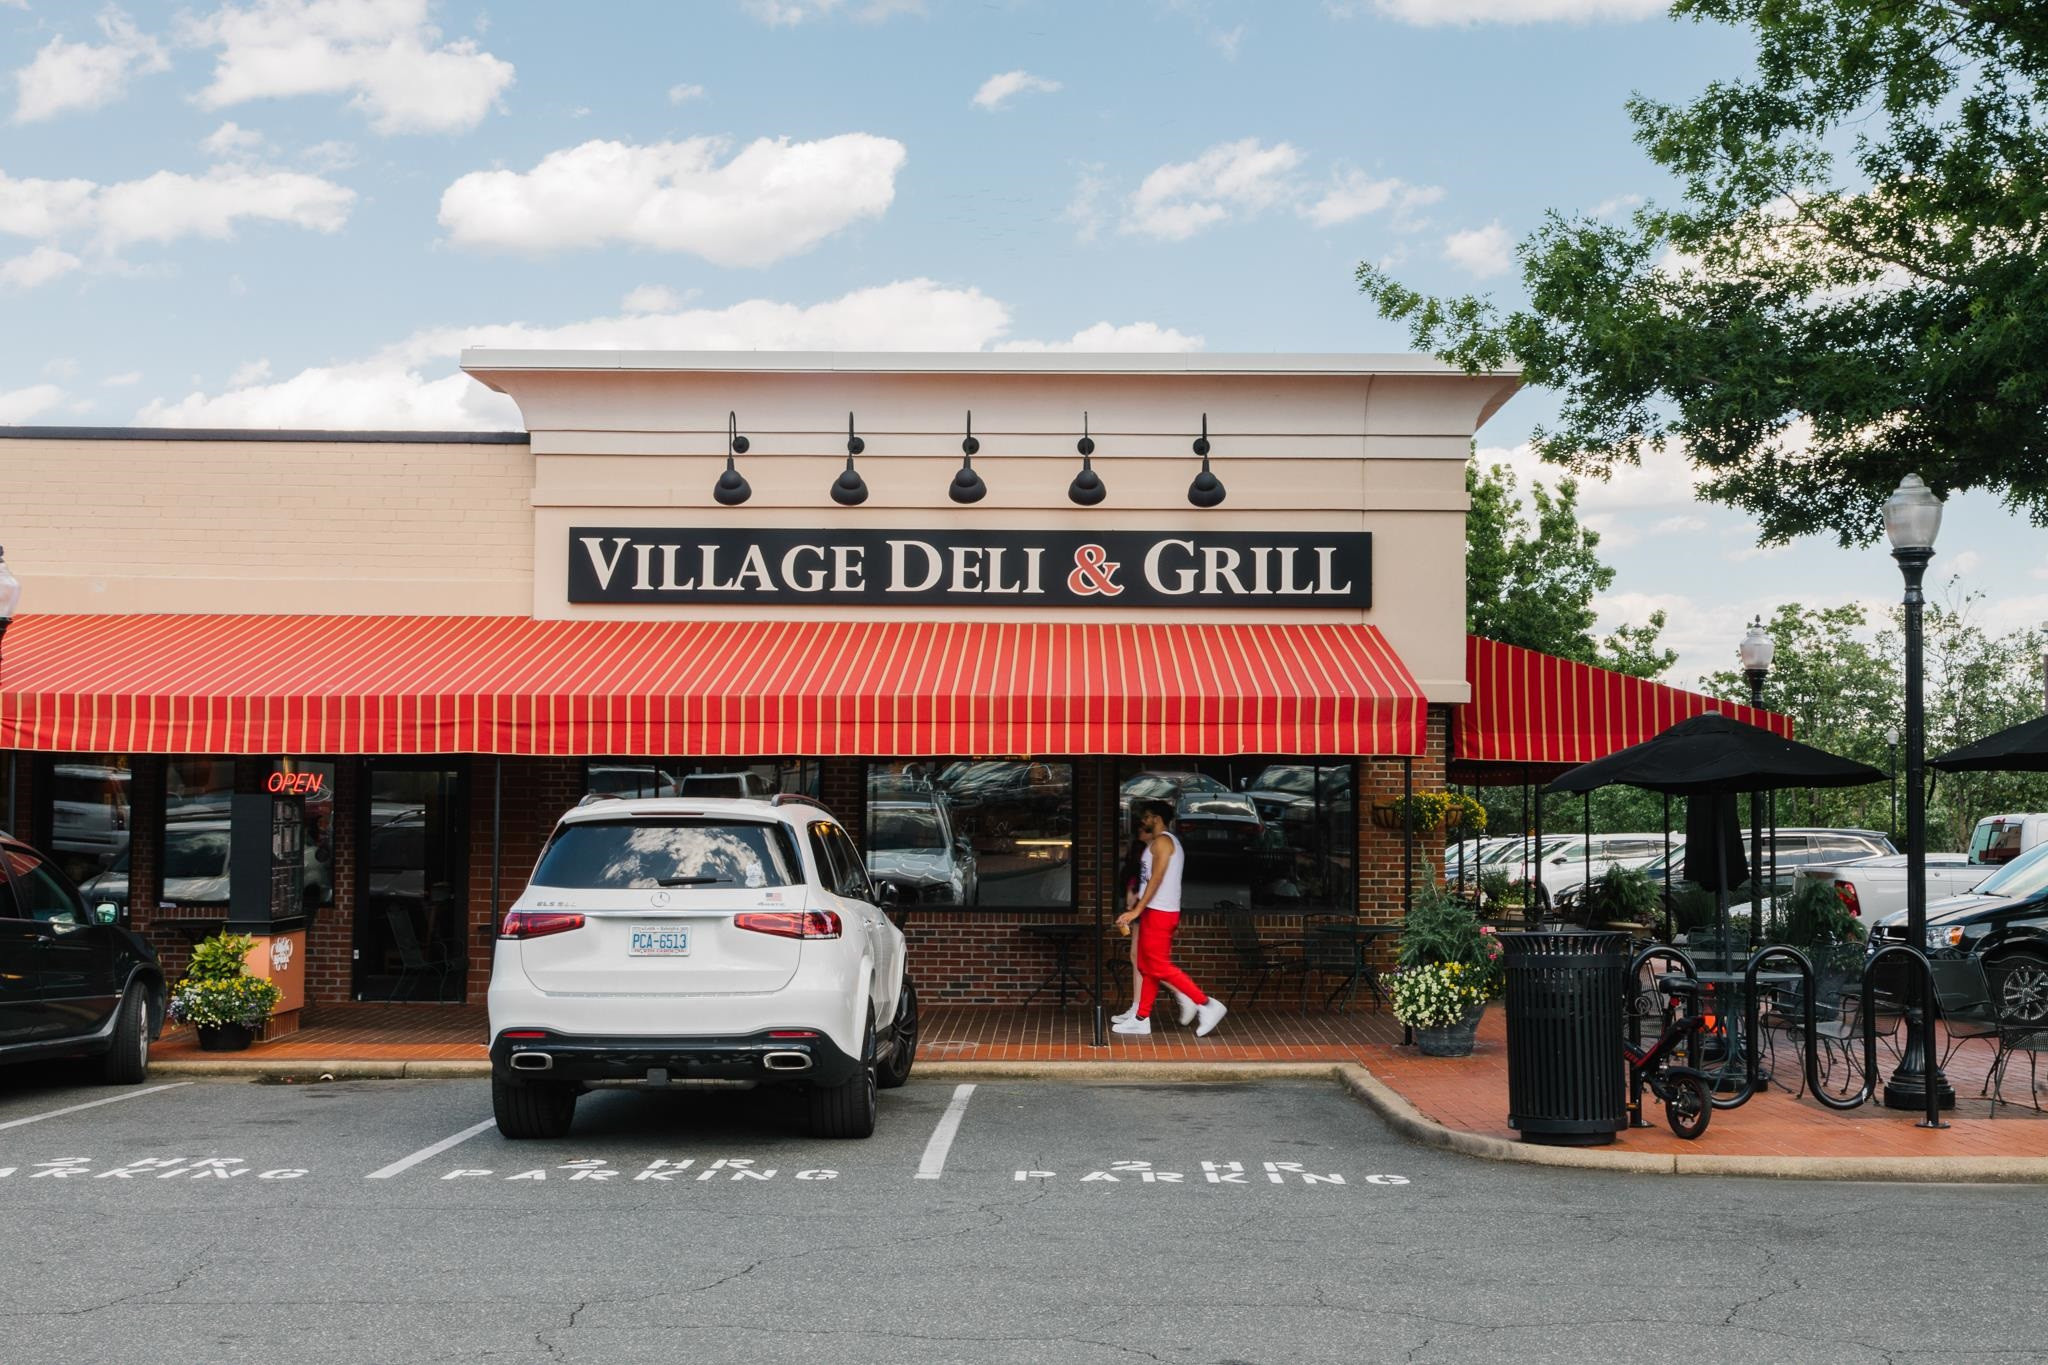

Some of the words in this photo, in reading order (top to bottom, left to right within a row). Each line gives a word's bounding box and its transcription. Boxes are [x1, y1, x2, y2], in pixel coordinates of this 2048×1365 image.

[579, 537, 866, 592] VILLAGE
[884, 540, 1046, 594] DELI
[1066, 543, 1126, 597] &
[1143, 538, 1353, 596] GRILL
[267, 771, 323, 793] OPEN
[632, 933, 687, 949] PCA-6513
[31, 1156, 92, 1167] 2
[125, 1157, 245, 1168] HR
[556, 1158, 608, 1170] 2
[646, 1158, 755, 1170] HR
[1110, 1160, 1152, 1171] 2
[1200, 1160, 1306, 1173] HR
[439, 1168, 840, 1181] PARKING
[1013, 1170, 1411, 1185] PARKING
